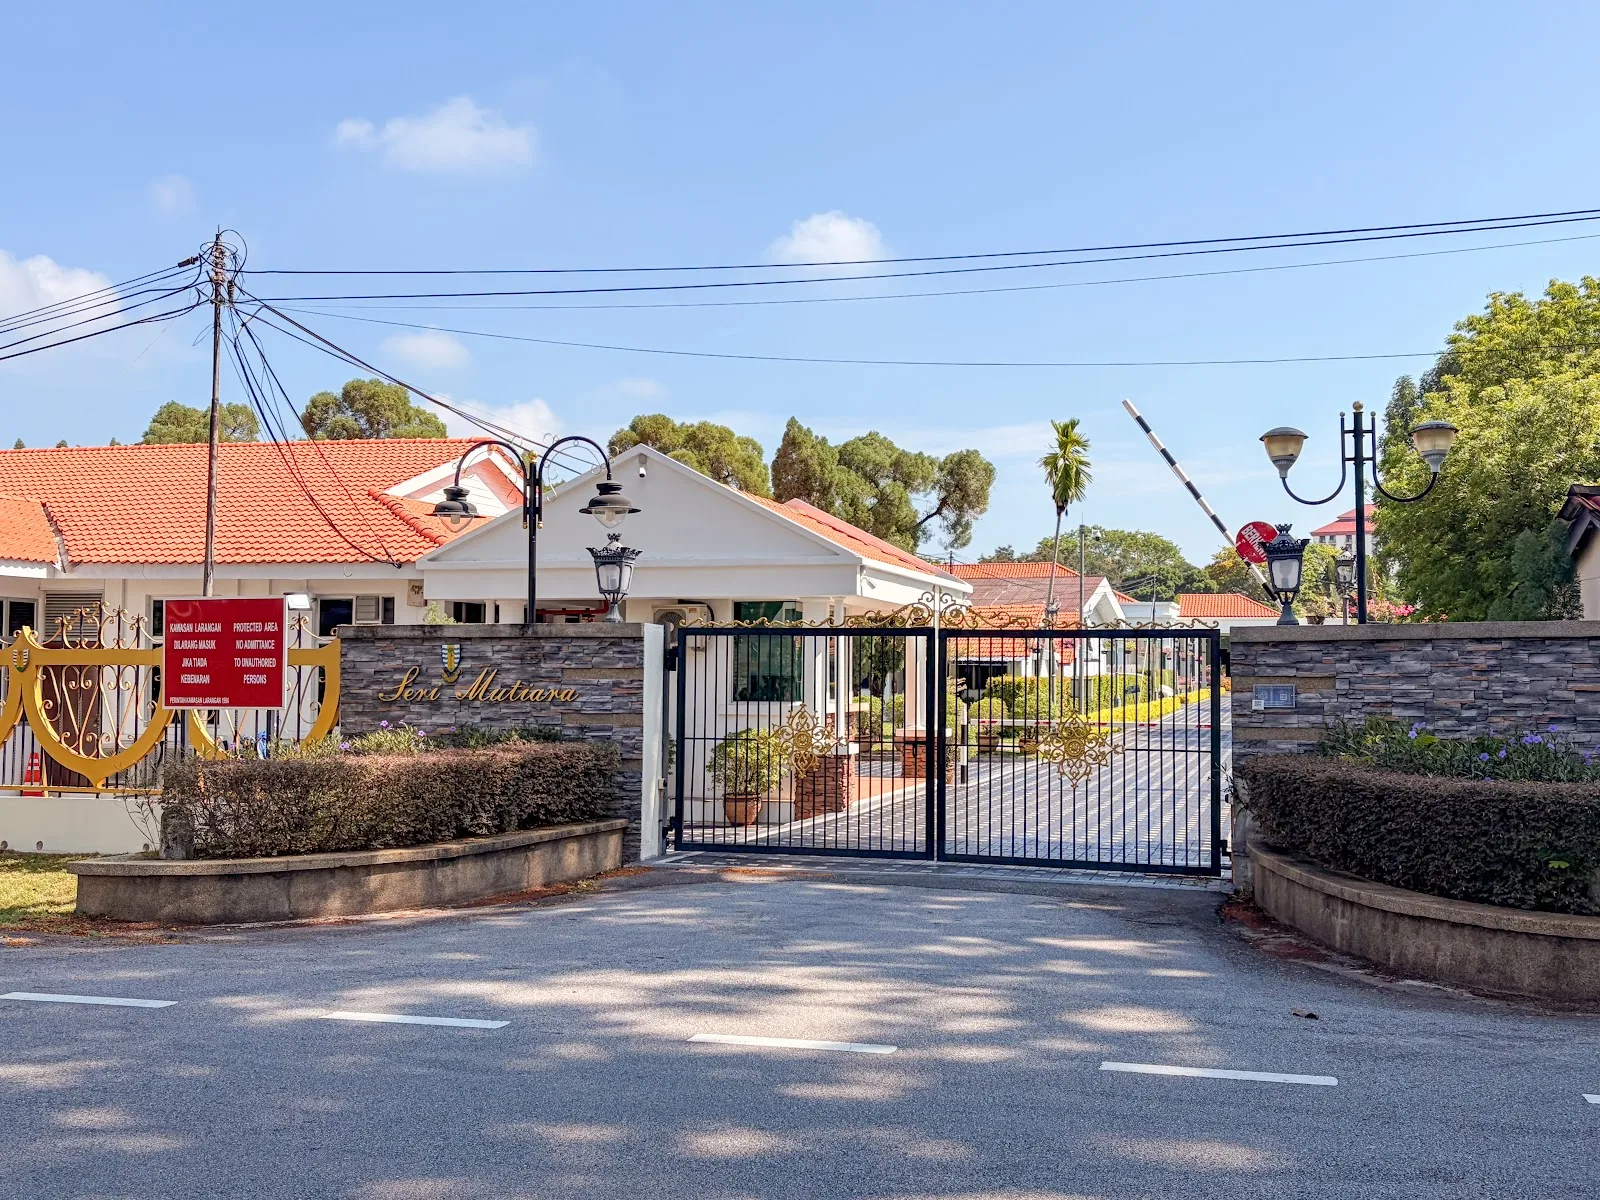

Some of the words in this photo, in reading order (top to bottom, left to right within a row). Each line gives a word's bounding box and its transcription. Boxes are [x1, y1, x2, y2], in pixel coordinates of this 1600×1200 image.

[170, 623, 193, 632] KAWASAN
[195, 623, 221, 632] LARANGAN
[234, 622, 262, 632] PROTECTED
[264, 622, 278, 631] AREA
[174, 640, 198, 649] DILARANG
[198, 640, 216, 649] MASUK
[236, 640, 243, 649] NO
[244, 640, 275, 649] ADMITTANCE
[182, 658, 192, 667] JIKA
[193, 658, 207, 667] TIADA
[234, 658, 241, 667] TO
[181, 674, 210, 684] KEBENARAN
[244, 674, 267, 684] PERSONS
[378, 666, 441, 702] Seri
[456, 667, 579, 702] Mutiara
